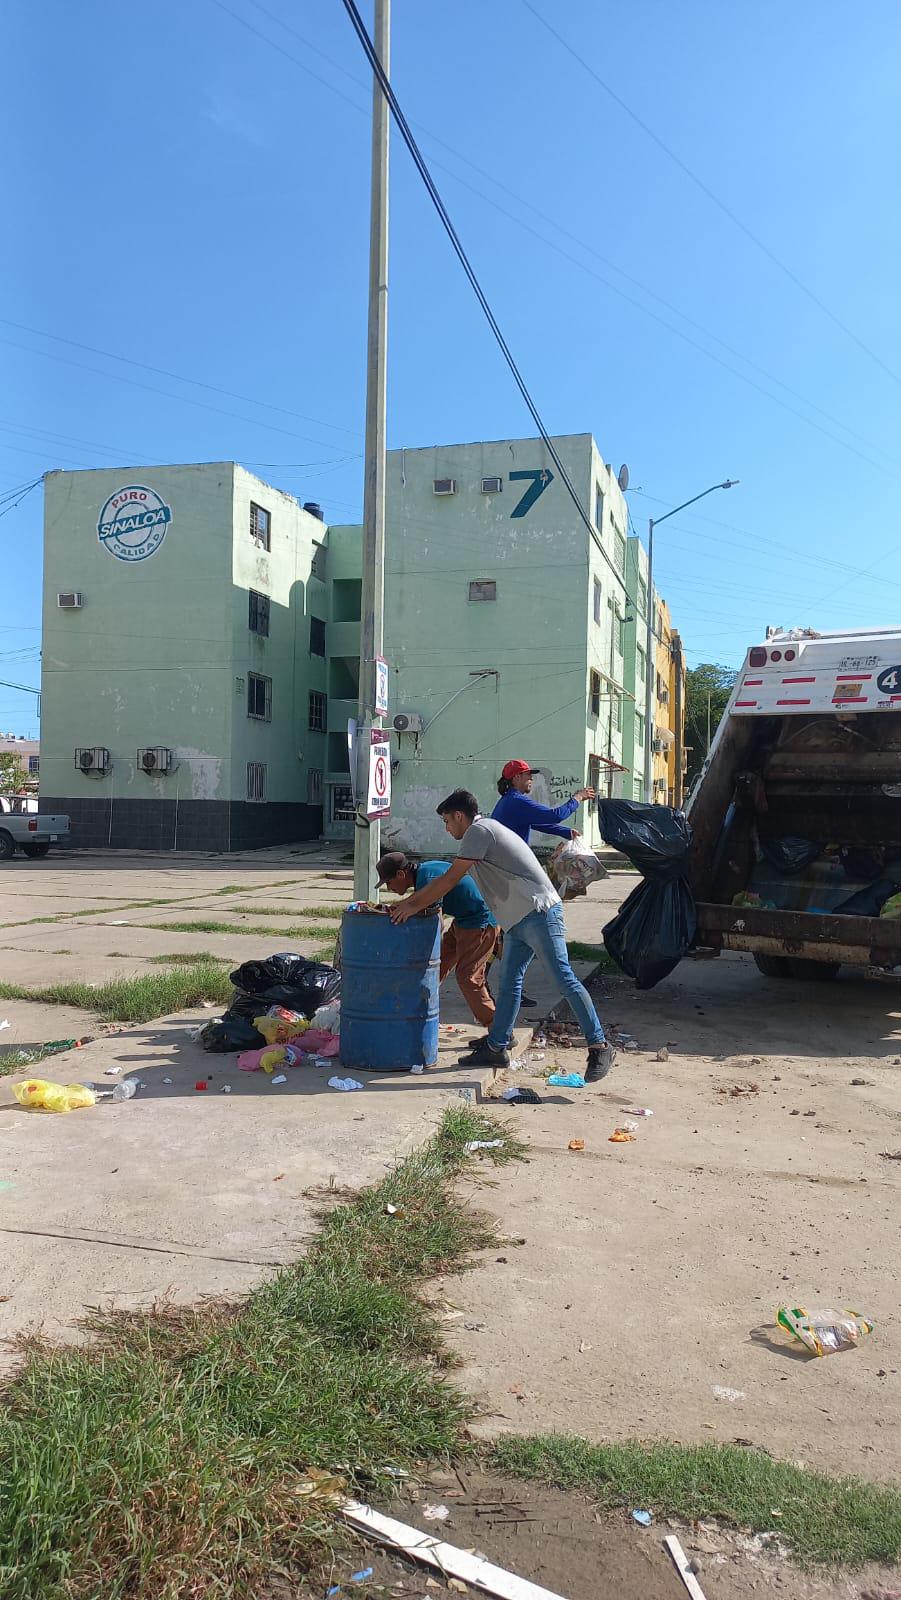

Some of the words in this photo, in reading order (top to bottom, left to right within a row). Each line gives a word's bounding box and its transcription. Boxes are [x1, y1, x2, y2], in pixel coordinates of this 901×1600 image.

[112, 491, 147, 509] PURO
[509, 469, 554, 518] 7
[100, 509, 166, 538] SINALOA
[113, 533, 160, 556] CALIDAD
[882, 671, 898, 689] 4
